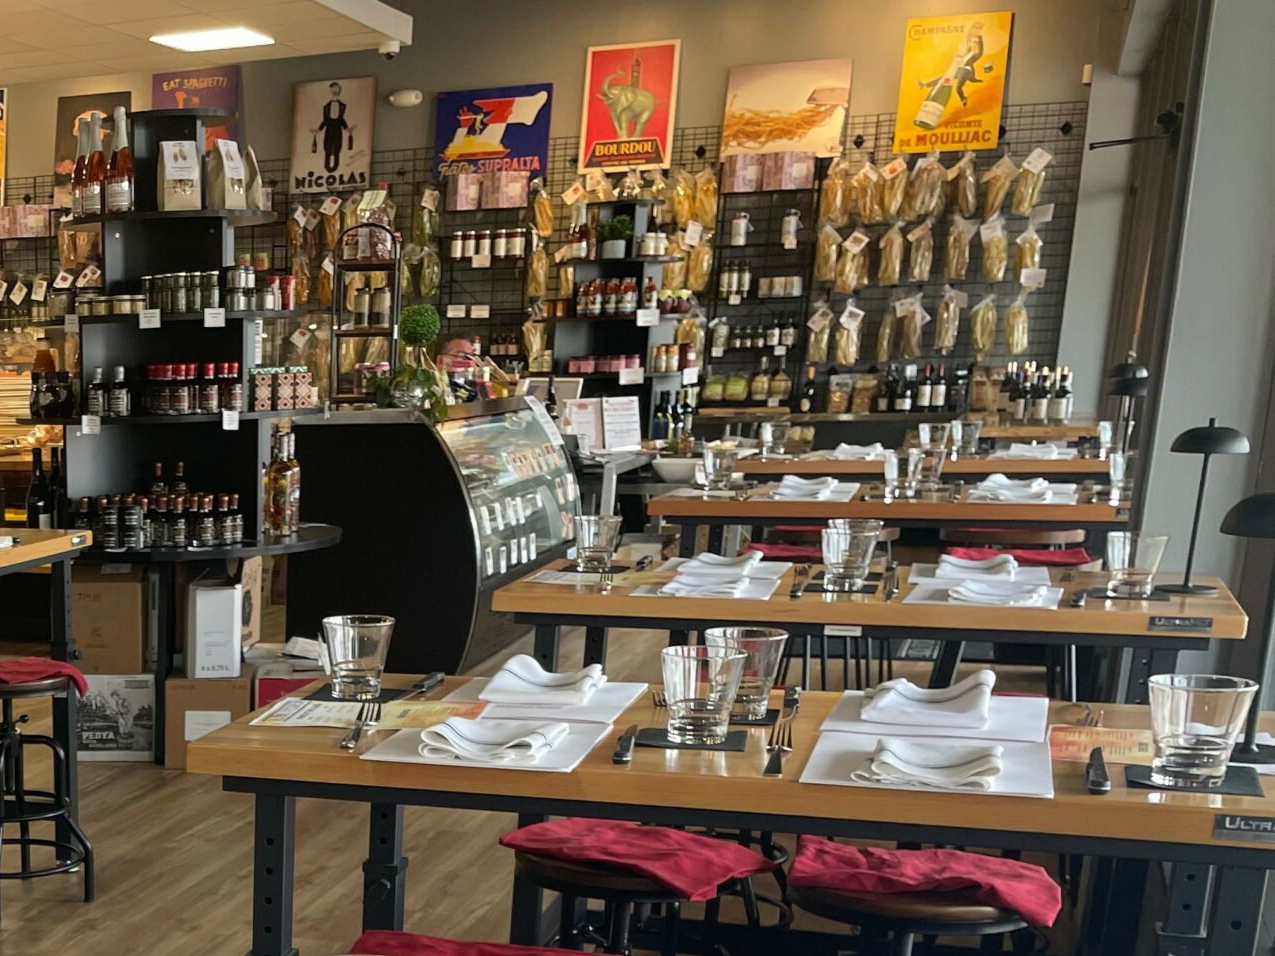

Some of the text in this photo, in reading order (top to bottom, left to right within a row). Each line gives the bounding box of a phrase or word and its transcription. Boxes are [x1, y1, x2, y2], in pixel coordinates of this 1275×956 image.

[908, 24, 966, 41] CHAMPAGNE
[162, 79, 182, 92] EAT
[916, 129, 993, 146] MOULLIAC
[594, 141, 657, 157] BOURDOU
[477, 156, 541, 173] SUPRALTA
[1225, 816, 1275, 832] ULTR
